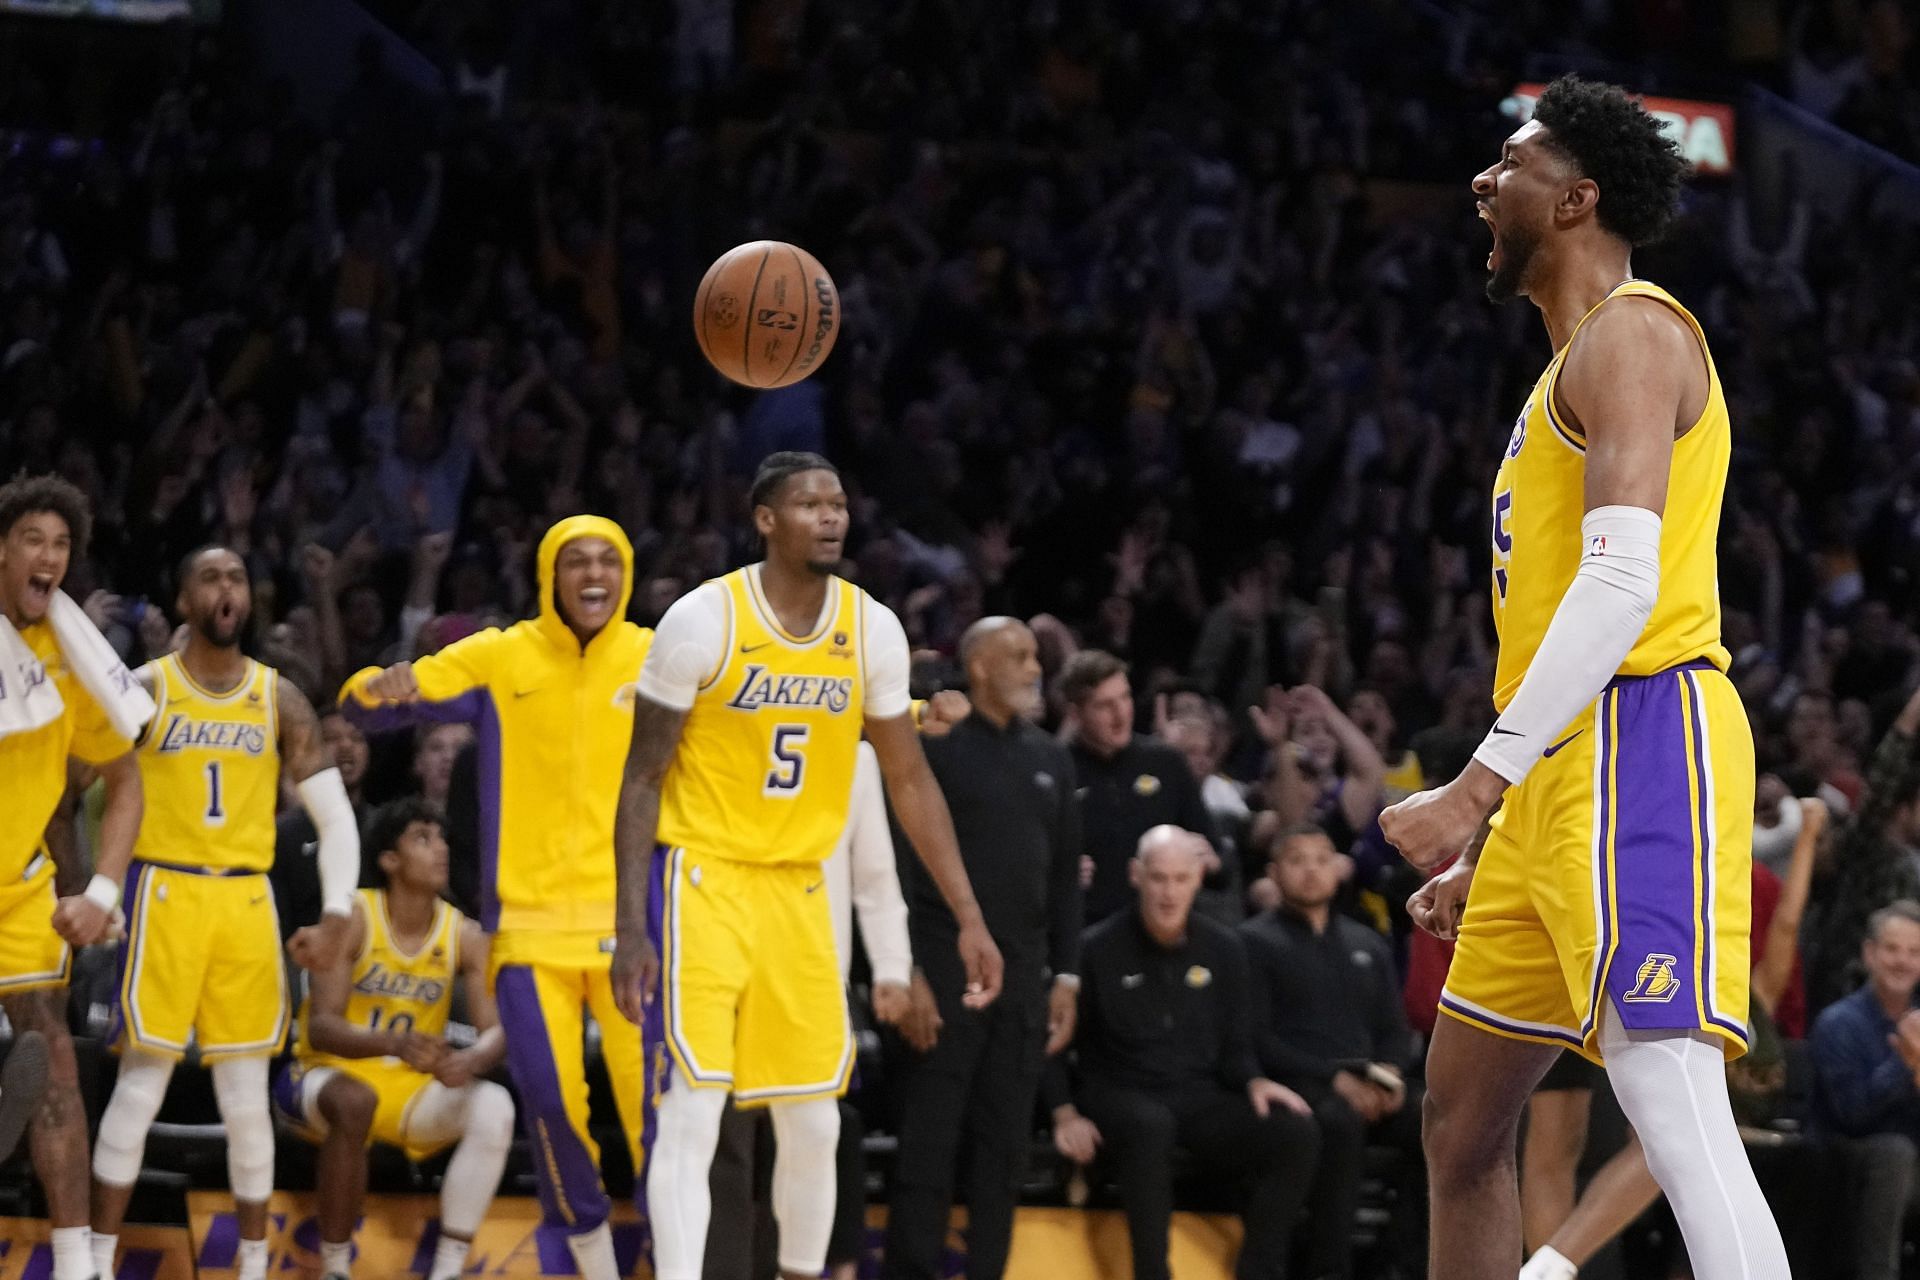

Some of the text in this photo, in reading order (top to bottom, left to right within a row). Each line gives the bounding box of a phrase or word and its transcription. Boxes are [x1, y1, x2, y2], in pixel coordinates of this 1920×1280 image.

[726, 664, 853, 714] LAKERS
[158, 715, 266, 756] LAKERS
[764, 723, 810, 797] 5
[204, 760, 225, 826] 1
[353, 962, 446, 1006] LAKERS
